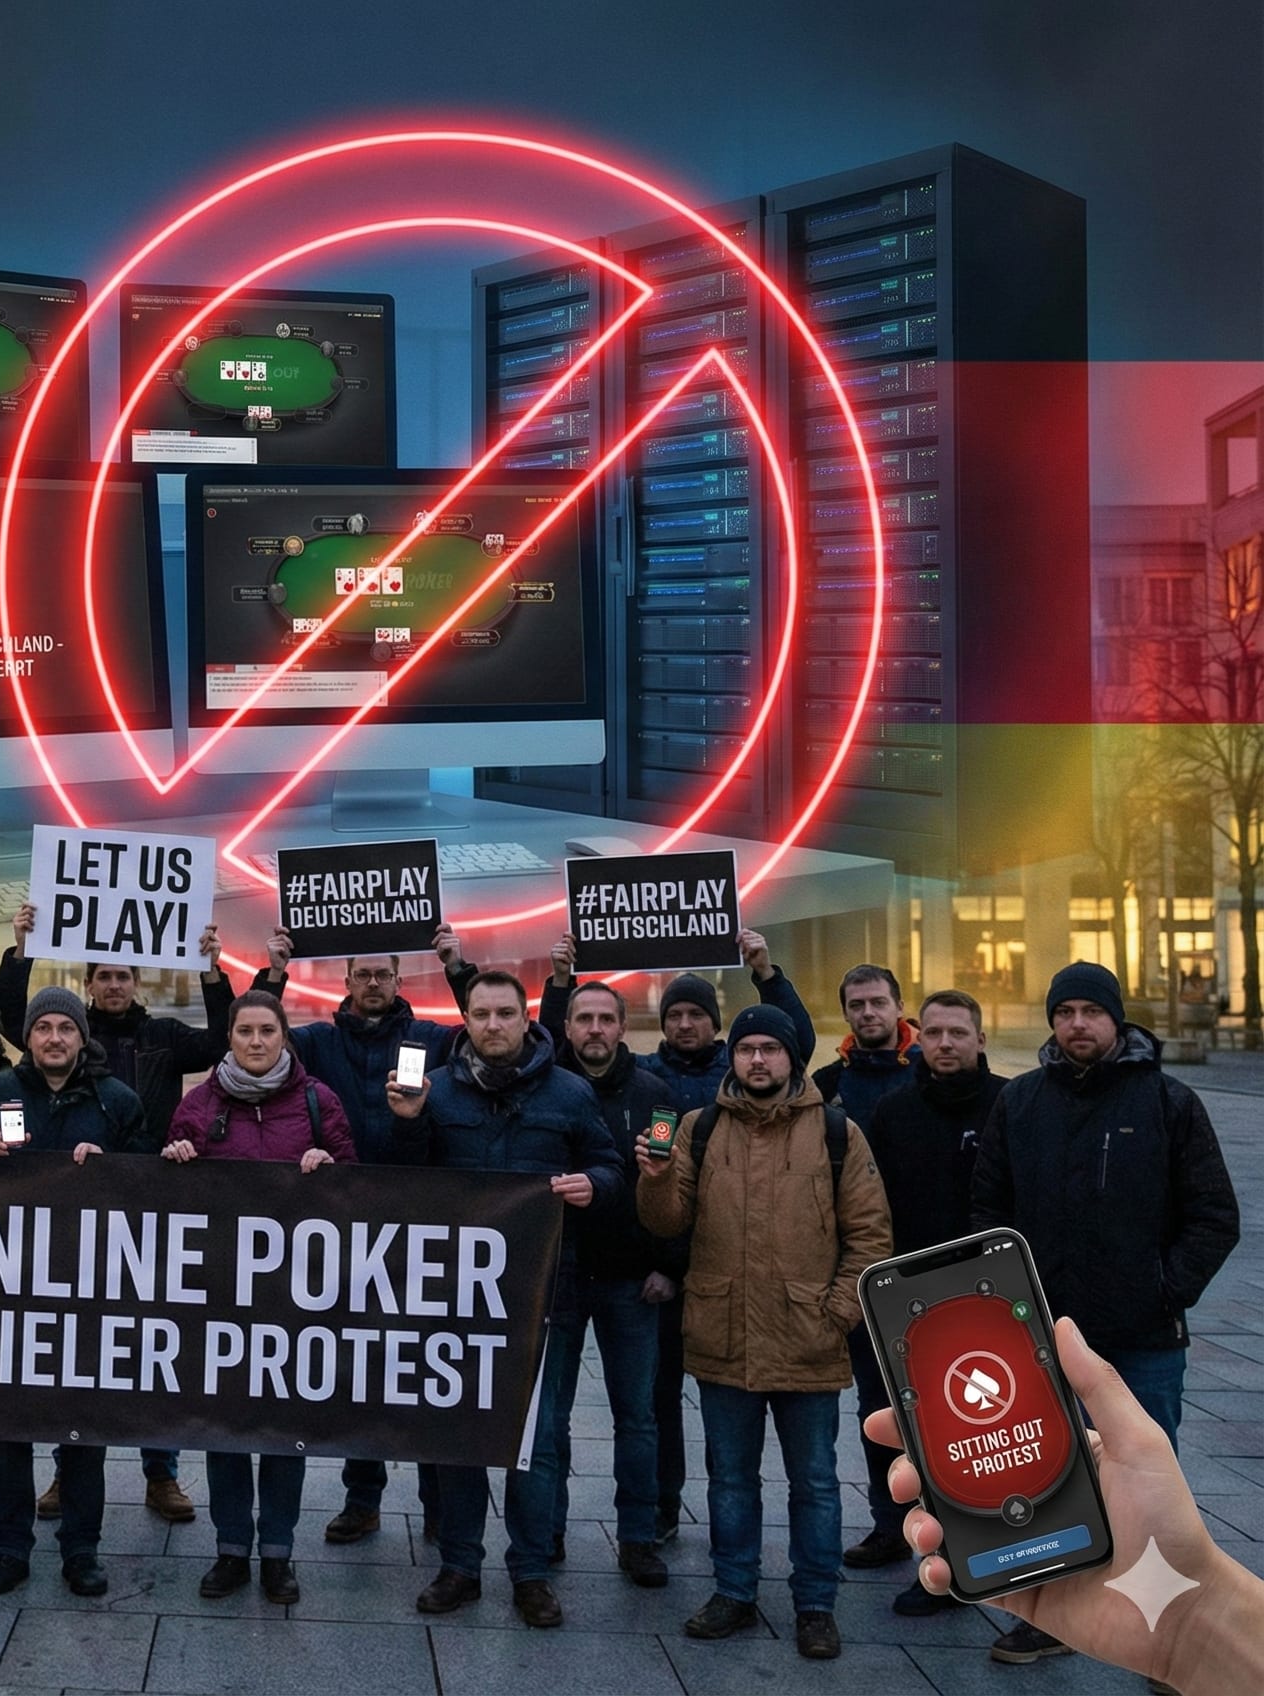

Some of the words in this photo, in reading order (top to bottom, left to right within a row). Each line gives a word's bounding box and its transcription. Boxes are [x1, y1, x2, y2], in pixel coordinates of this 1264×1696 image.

[55, 839, 128, 888] LET
[139, 845, 192, 894] US
[286, 866, 429, 904] #FAIRPLAY
[289, 899, 433, 930] DEUTSCHLAND
[576, 879, 727, 915] #FAIRPLAY
[51, 893, 188, 957] PLAY!
[579, 912, 730, 942] DEUTSCHLAND
[235, 1215, 508, 1319] POKER
[203, 1320, 507, 1410] PROTEST
[947, 1427, 1010, 1463] SITTING
[1013, 1418, 1044, 1443] OUT
[972, 1442, 1043, 1478] PROTEST
